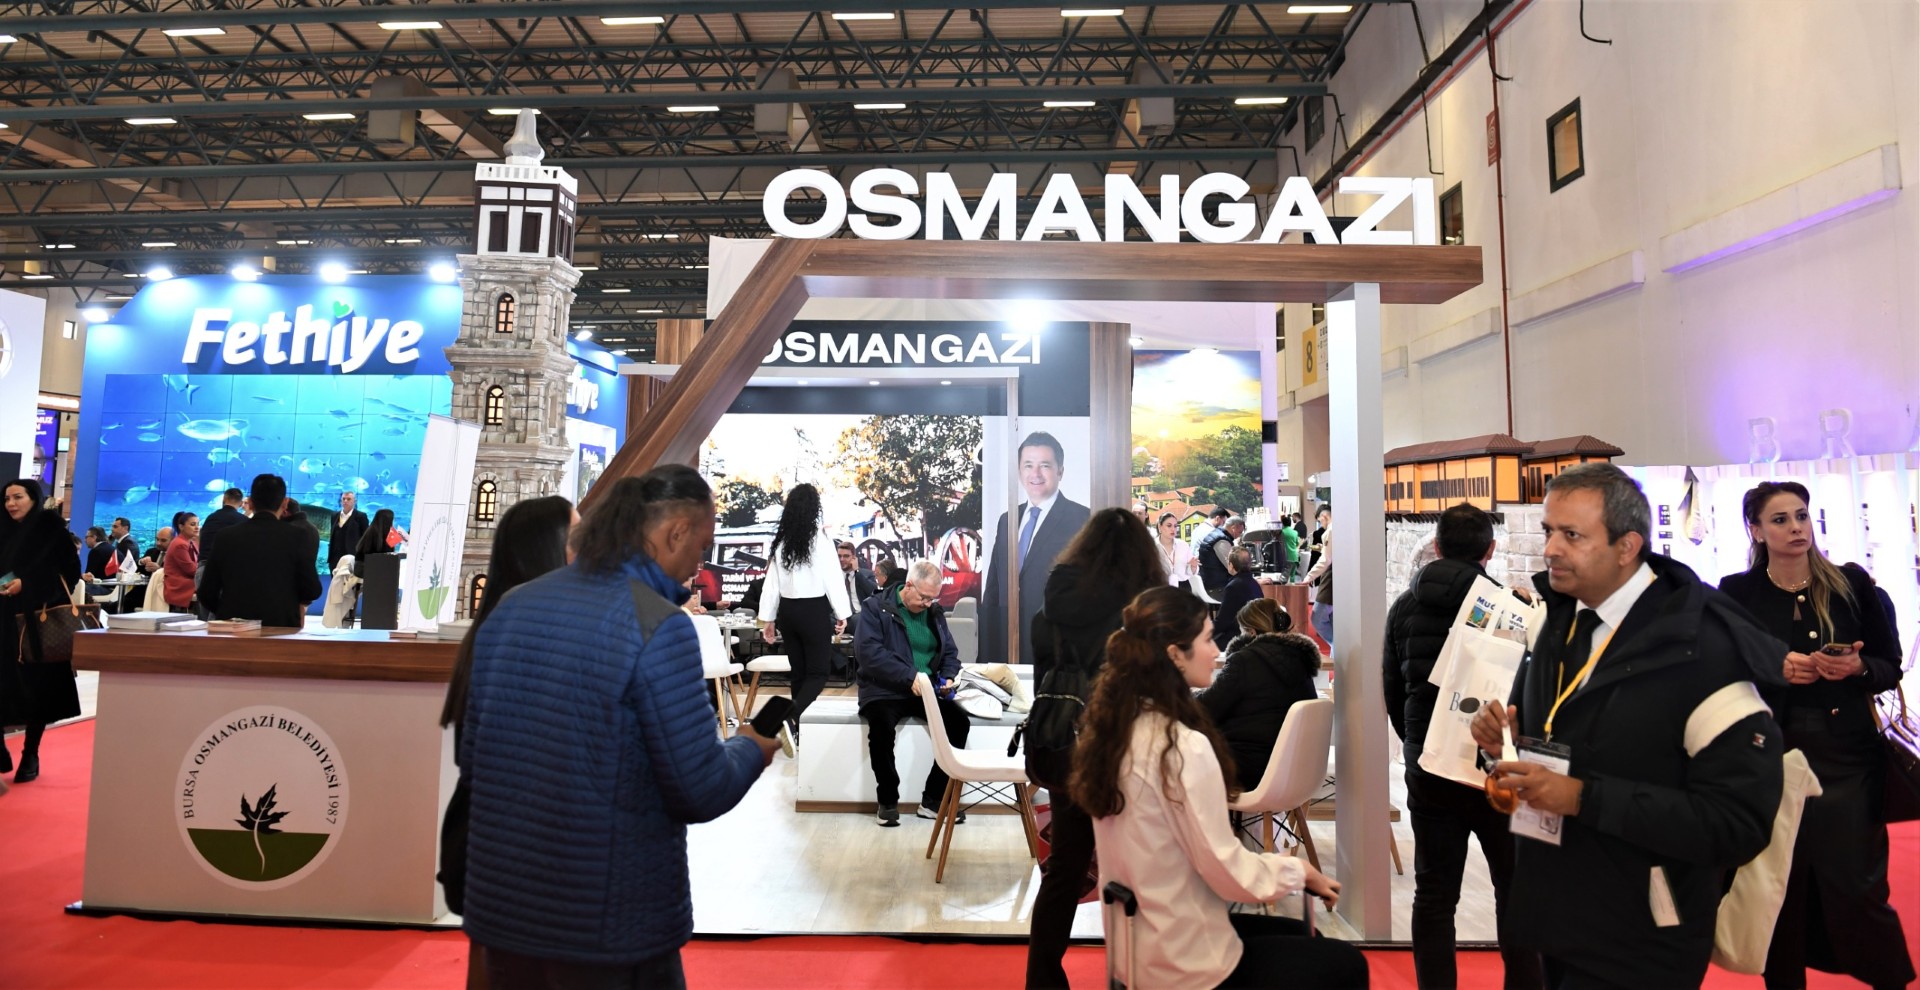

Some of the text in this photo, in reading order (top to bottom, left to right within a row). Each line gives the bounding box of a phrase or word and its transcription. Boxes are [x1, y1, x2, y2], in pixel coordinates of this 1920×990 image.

[763, 168, 1436, 245] OSMANGAZI
[182, 301, 423, 374] Fethiye
[1306, 340, 1314, 373] 8
[183, 713, 342, 825] BURSA OSMANGAZİ BELEDİYESİ 1987
